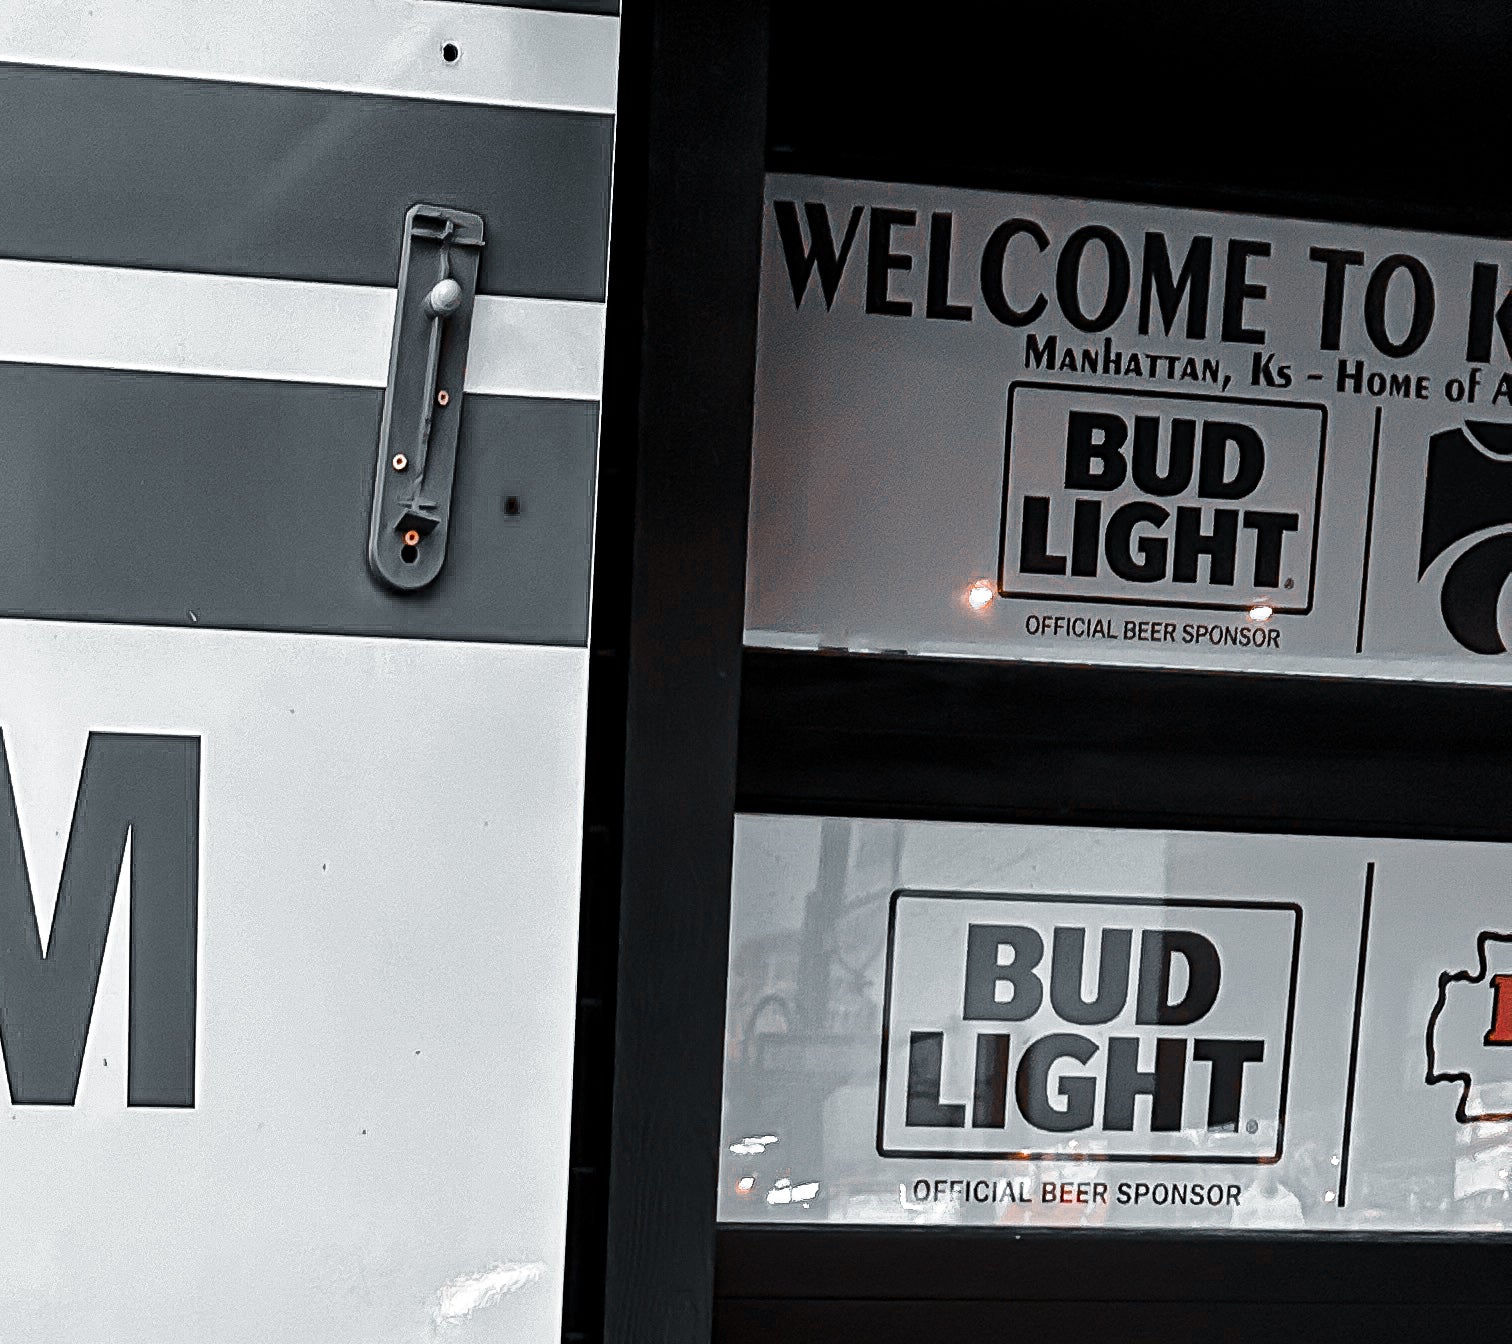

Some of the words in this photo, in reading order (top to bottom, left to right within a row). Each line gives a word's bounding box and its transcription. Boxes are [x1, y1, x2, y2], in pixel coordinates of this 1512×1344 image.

[773, 200, 1272, 346] WELCOME
[1309, 247, 1435, 359] TO
[1063, 409, 1265, 502] BUD
[1019, 495, 1299, 589] LIGHT
[1026, 614, 1118, 640] OFFICIAL
[1123, 620, 1177, 644] BEER
[1182, 624, 1281, 649] SPONSOR
[963, 923, 1222, 1028] BUD
[905, 1030, 1265, 1135] LIGHT
[913, 1179, 1033, 1203] OFFICIAL
[1041, 1182, 1108, 1205] BEER
[1116, 1183, 1241, 1207] SPONSOR
